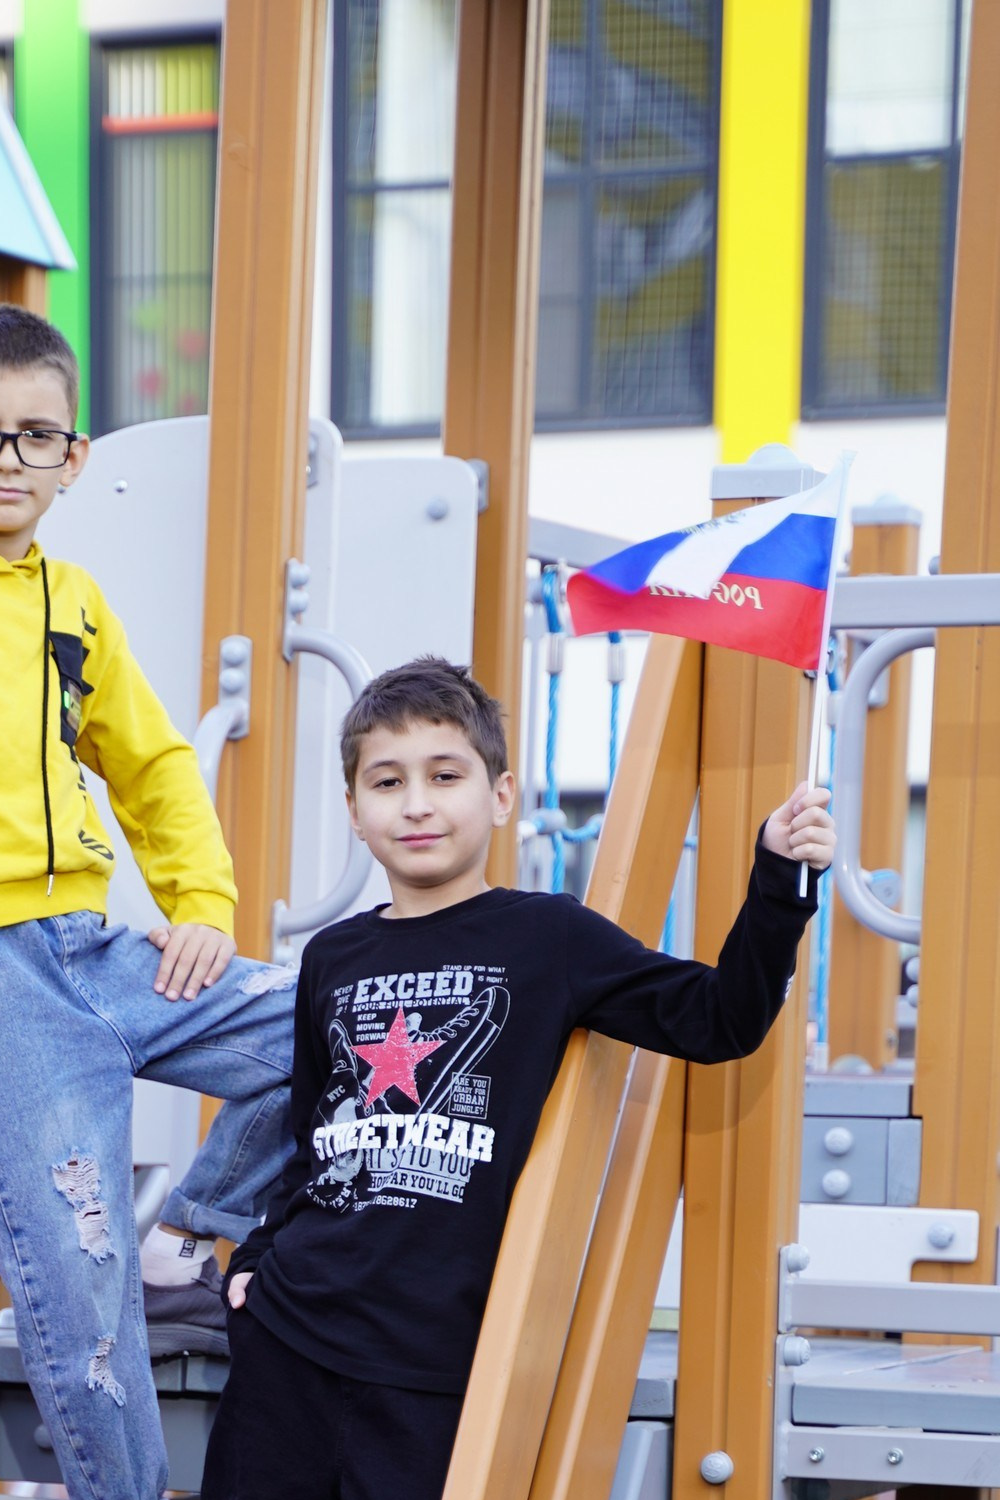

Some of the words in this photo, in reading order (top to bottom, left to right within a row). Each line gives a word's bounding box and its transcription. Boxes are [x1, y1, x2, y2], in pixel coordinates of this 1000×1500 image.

[488, 966, 506, 974] WHAT
[333, 984, 354, 998] NEVER
[354, 970, 474, 1004] EXCEED
[357, 1013, 377, 1022] KEEP
[356, 1022, 386, 1031] MOVING
[472, 1079, 487, 1088] YOU
[326, 1085, 346, 1103] NYC
[453, 1093, 486, 1106] URBAN
[451, 1104, 484, 1115] JUNGLE?
[312, 1113, 496, 1162] STREETWEAR
[439, 1150, 471, 1177] YOU
[411, 1174, 450, 1196] YOU'LL
